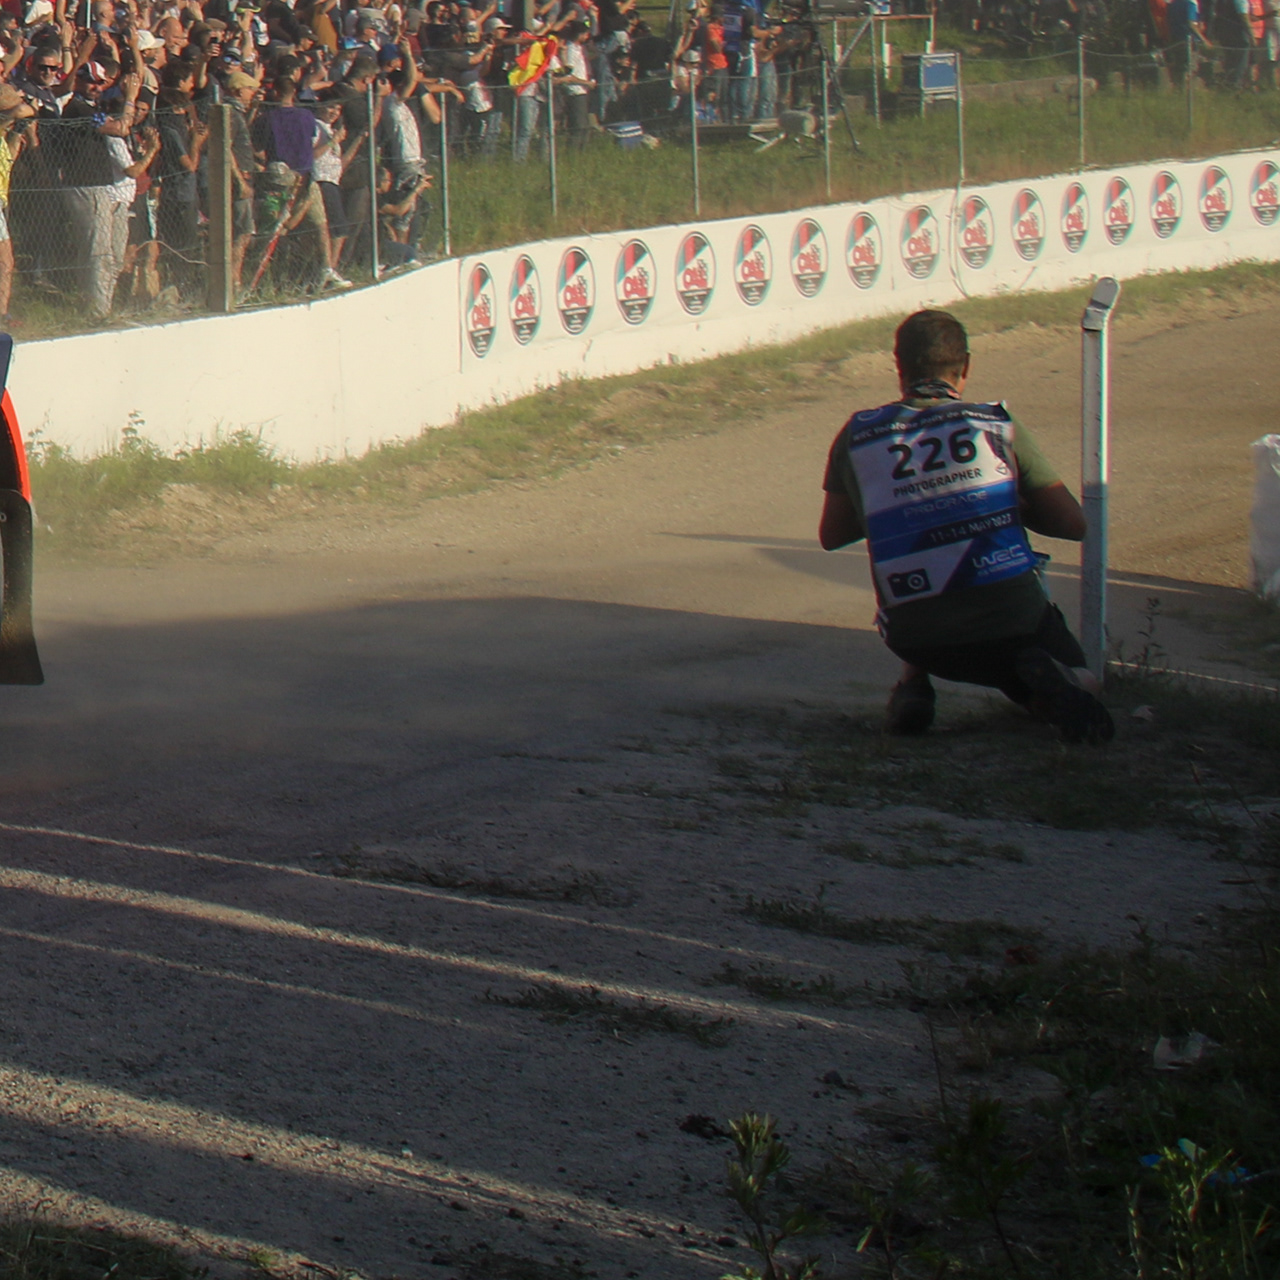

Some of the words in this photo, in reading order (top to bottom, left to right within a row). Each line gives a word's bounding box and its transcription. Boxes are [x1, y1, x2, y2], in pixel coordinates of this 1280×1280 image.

[887, 428, 978, 481] 226
[893, 467, 983, 498] PHOTOGRAPHER
[930, 526, 967, 543] 11-14
[968, 519, 991, 534] MAY
